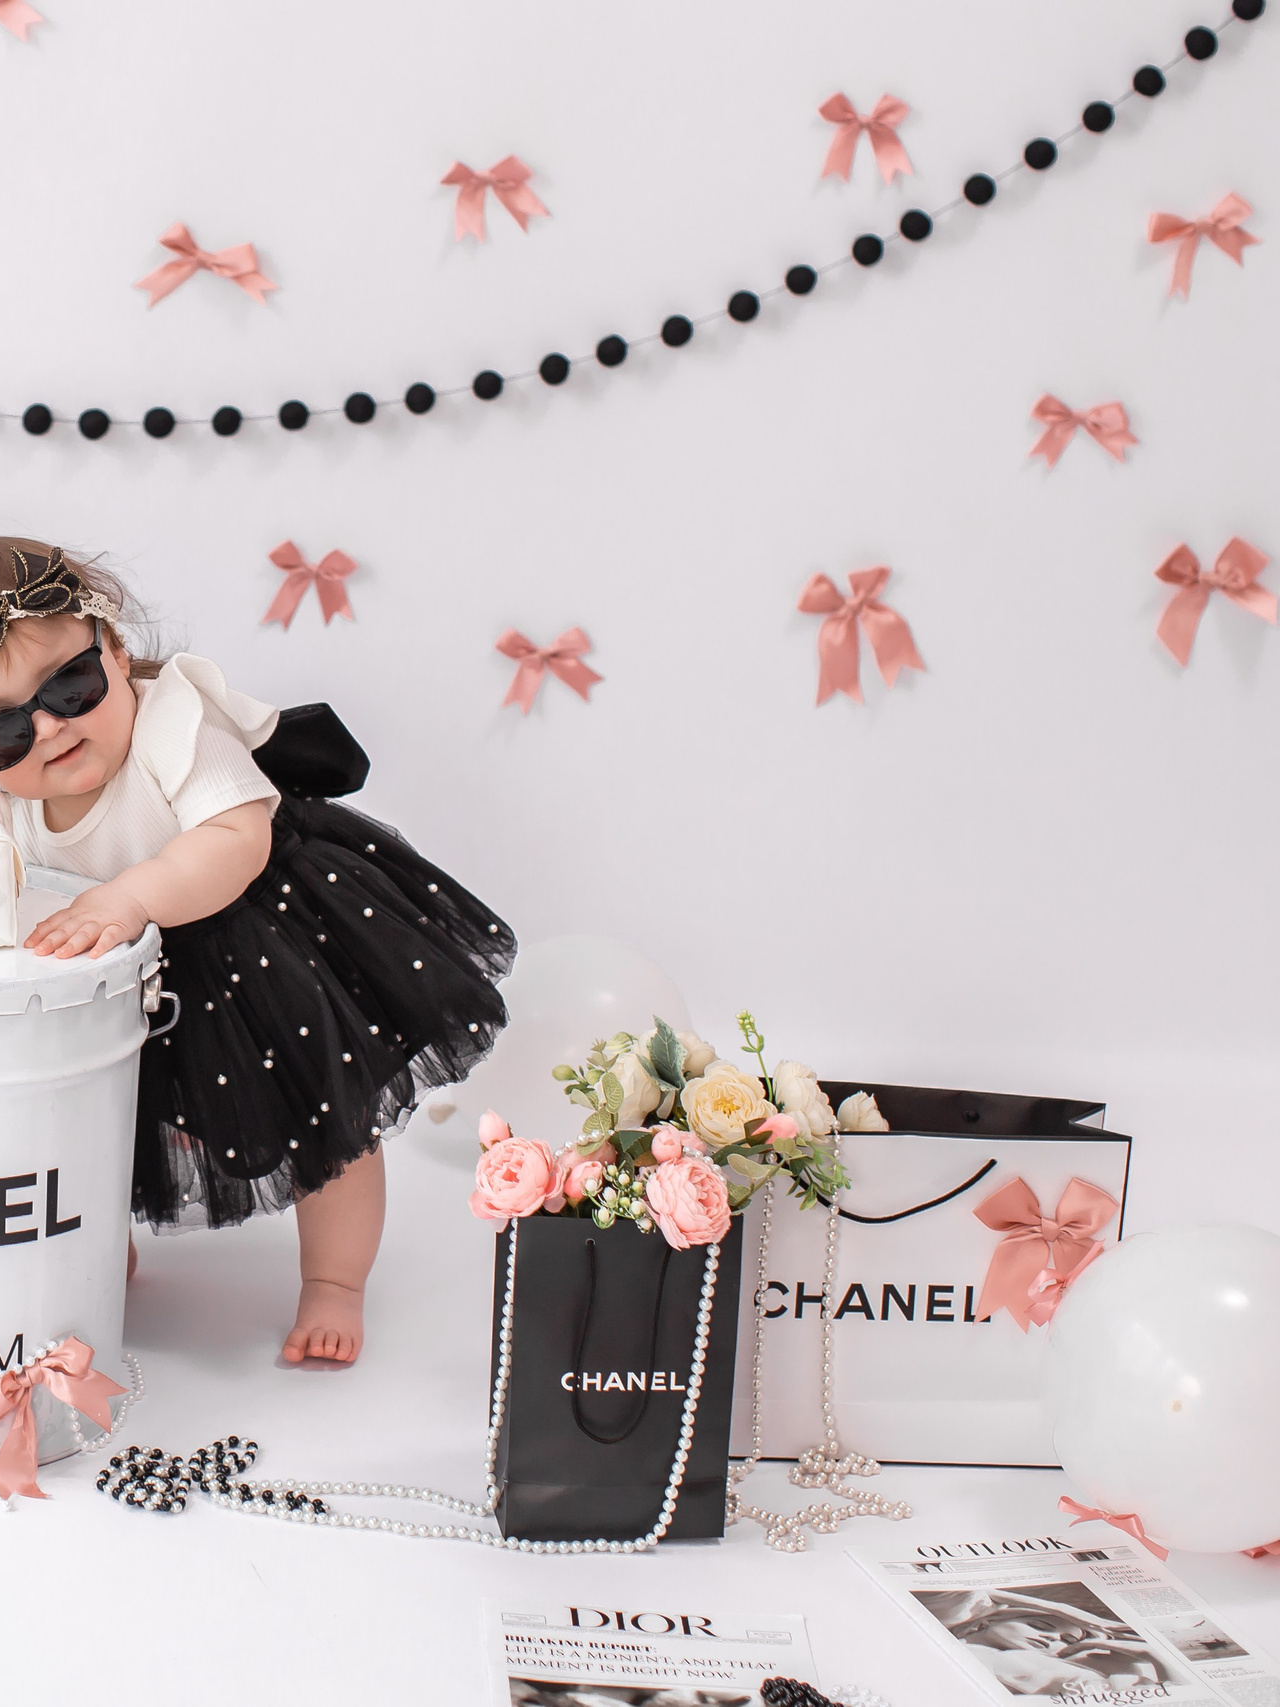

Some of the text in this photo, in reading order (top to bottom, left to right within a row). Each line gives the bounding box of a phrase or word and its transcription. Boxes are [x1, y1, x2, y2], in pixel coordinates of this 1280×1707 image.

[753, 1280, 992, 1323] CHANEL
[560, 1371, 686, 1392] CHANEL
[916, 1535, 1074, 1559] OUTLOOK
[565, 1606, 720, 1638] DIOR
[505, 1634, 657, 1653] BREAKING REPORT:
[505, 1644, 543, 1656] LIFE
[549, 1648, 565, 1657] IS
[570, 1650, 581, 1659] A
[681, 1657, 721, 1668] AND
[725, 1660, 776, 1670] THAT
[506, 1656, 594, 1672] MOMENT
[600, 1664, 616, 1673] IS
[621, 1665, 681, 1678] RIGHT
[1050, 1682, 1171, 1706] shrugged
